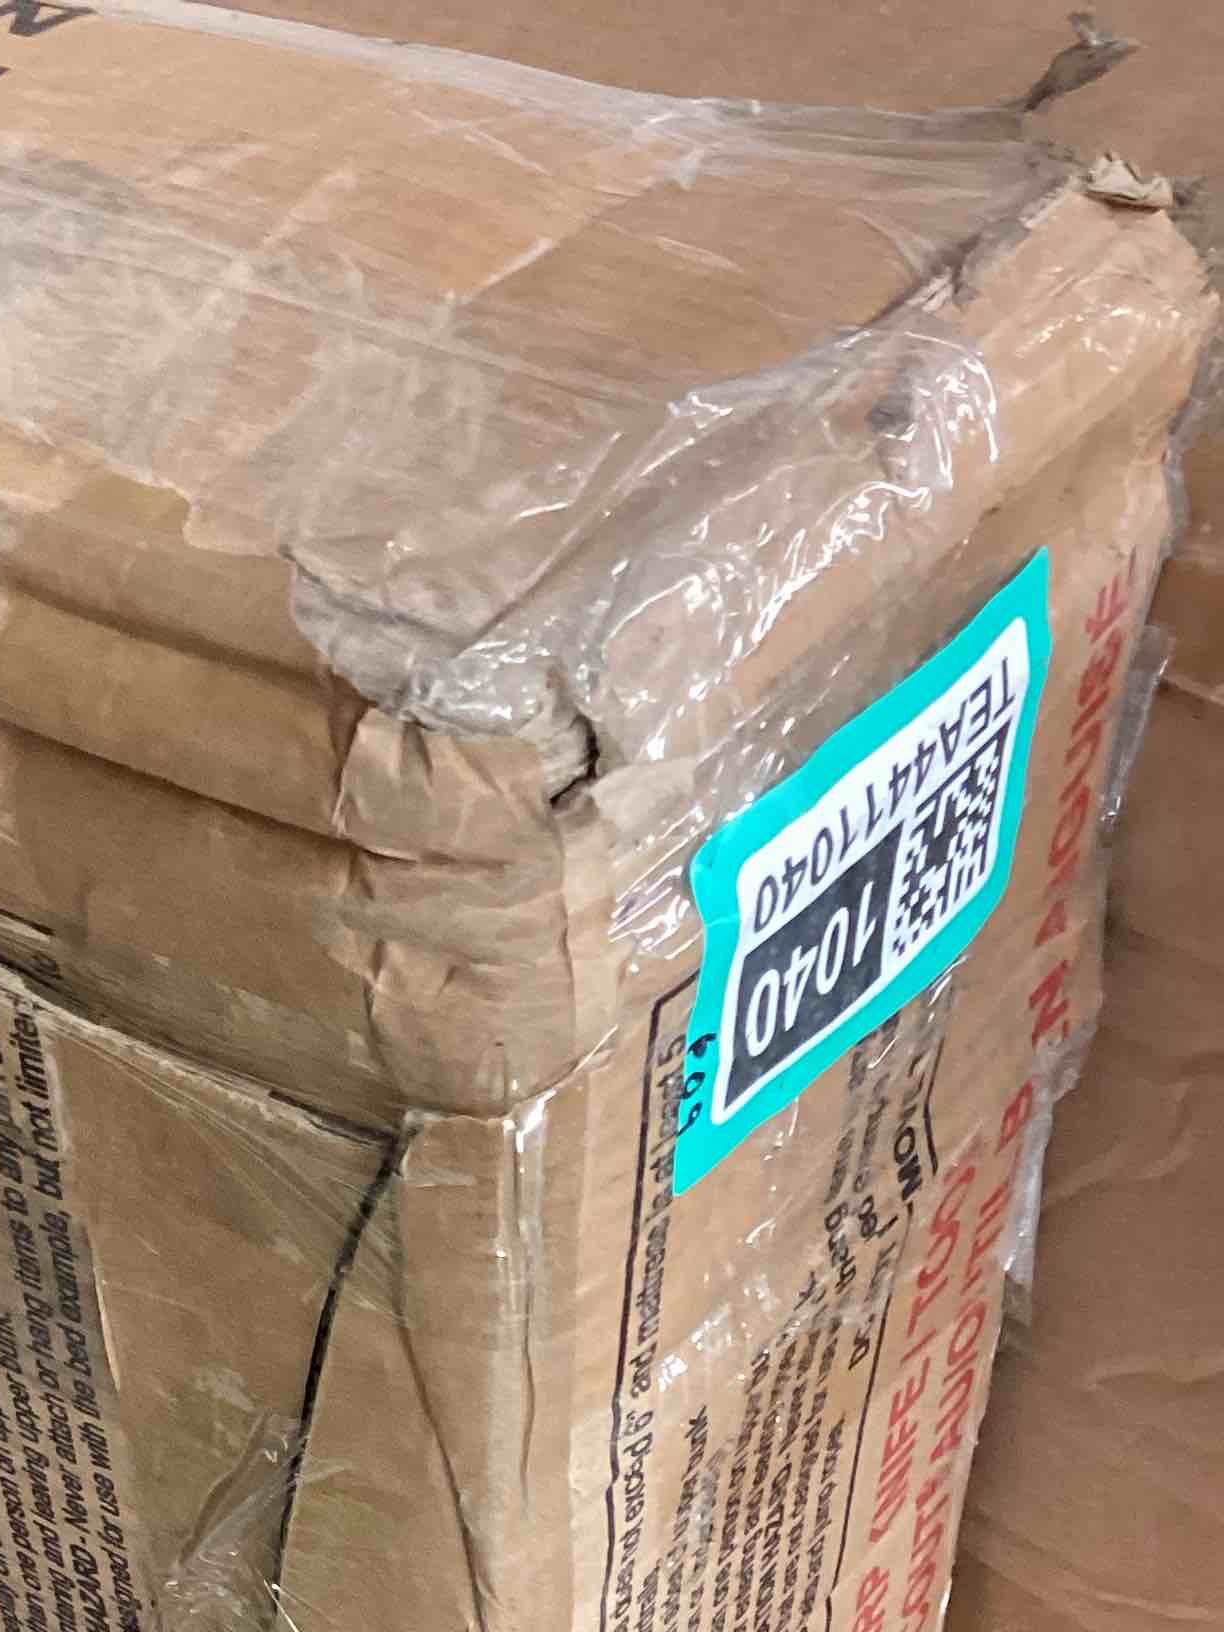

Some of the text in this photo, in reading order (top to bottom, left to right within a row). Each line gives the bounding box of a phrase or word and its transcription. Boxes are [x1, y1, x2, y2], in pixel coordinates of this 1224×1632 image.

[746, 878, 877, 1058] 1040
[17, 1095, 56, 1153] not
[26, 1147, 64, 1203] but
[3, 1212, 44, 1294] items
[35, 1197, 93, 1331] example,
[634, 1212, 670, 1349] mattress
[18, 1289, 65, 1367] hang
[58, 1320, 95, 1380] bed
[69, 1375, 102, 1423] the
[629, 1336, 659, 1406] and
[4, 1371, 45, 1449] upper
[37, 1386, 77, 1466] attach
[76, 1415, 111, 1473] with
[14, 1439, 62, 1528] leaving
[52, 1459, 91, 1536] Never
[92, 1469, 119, 1519] use
[32, 1519, 64, 1568] and
[95, 1510, 125, 1552] for
[16, 1549, 40, 1592] one
